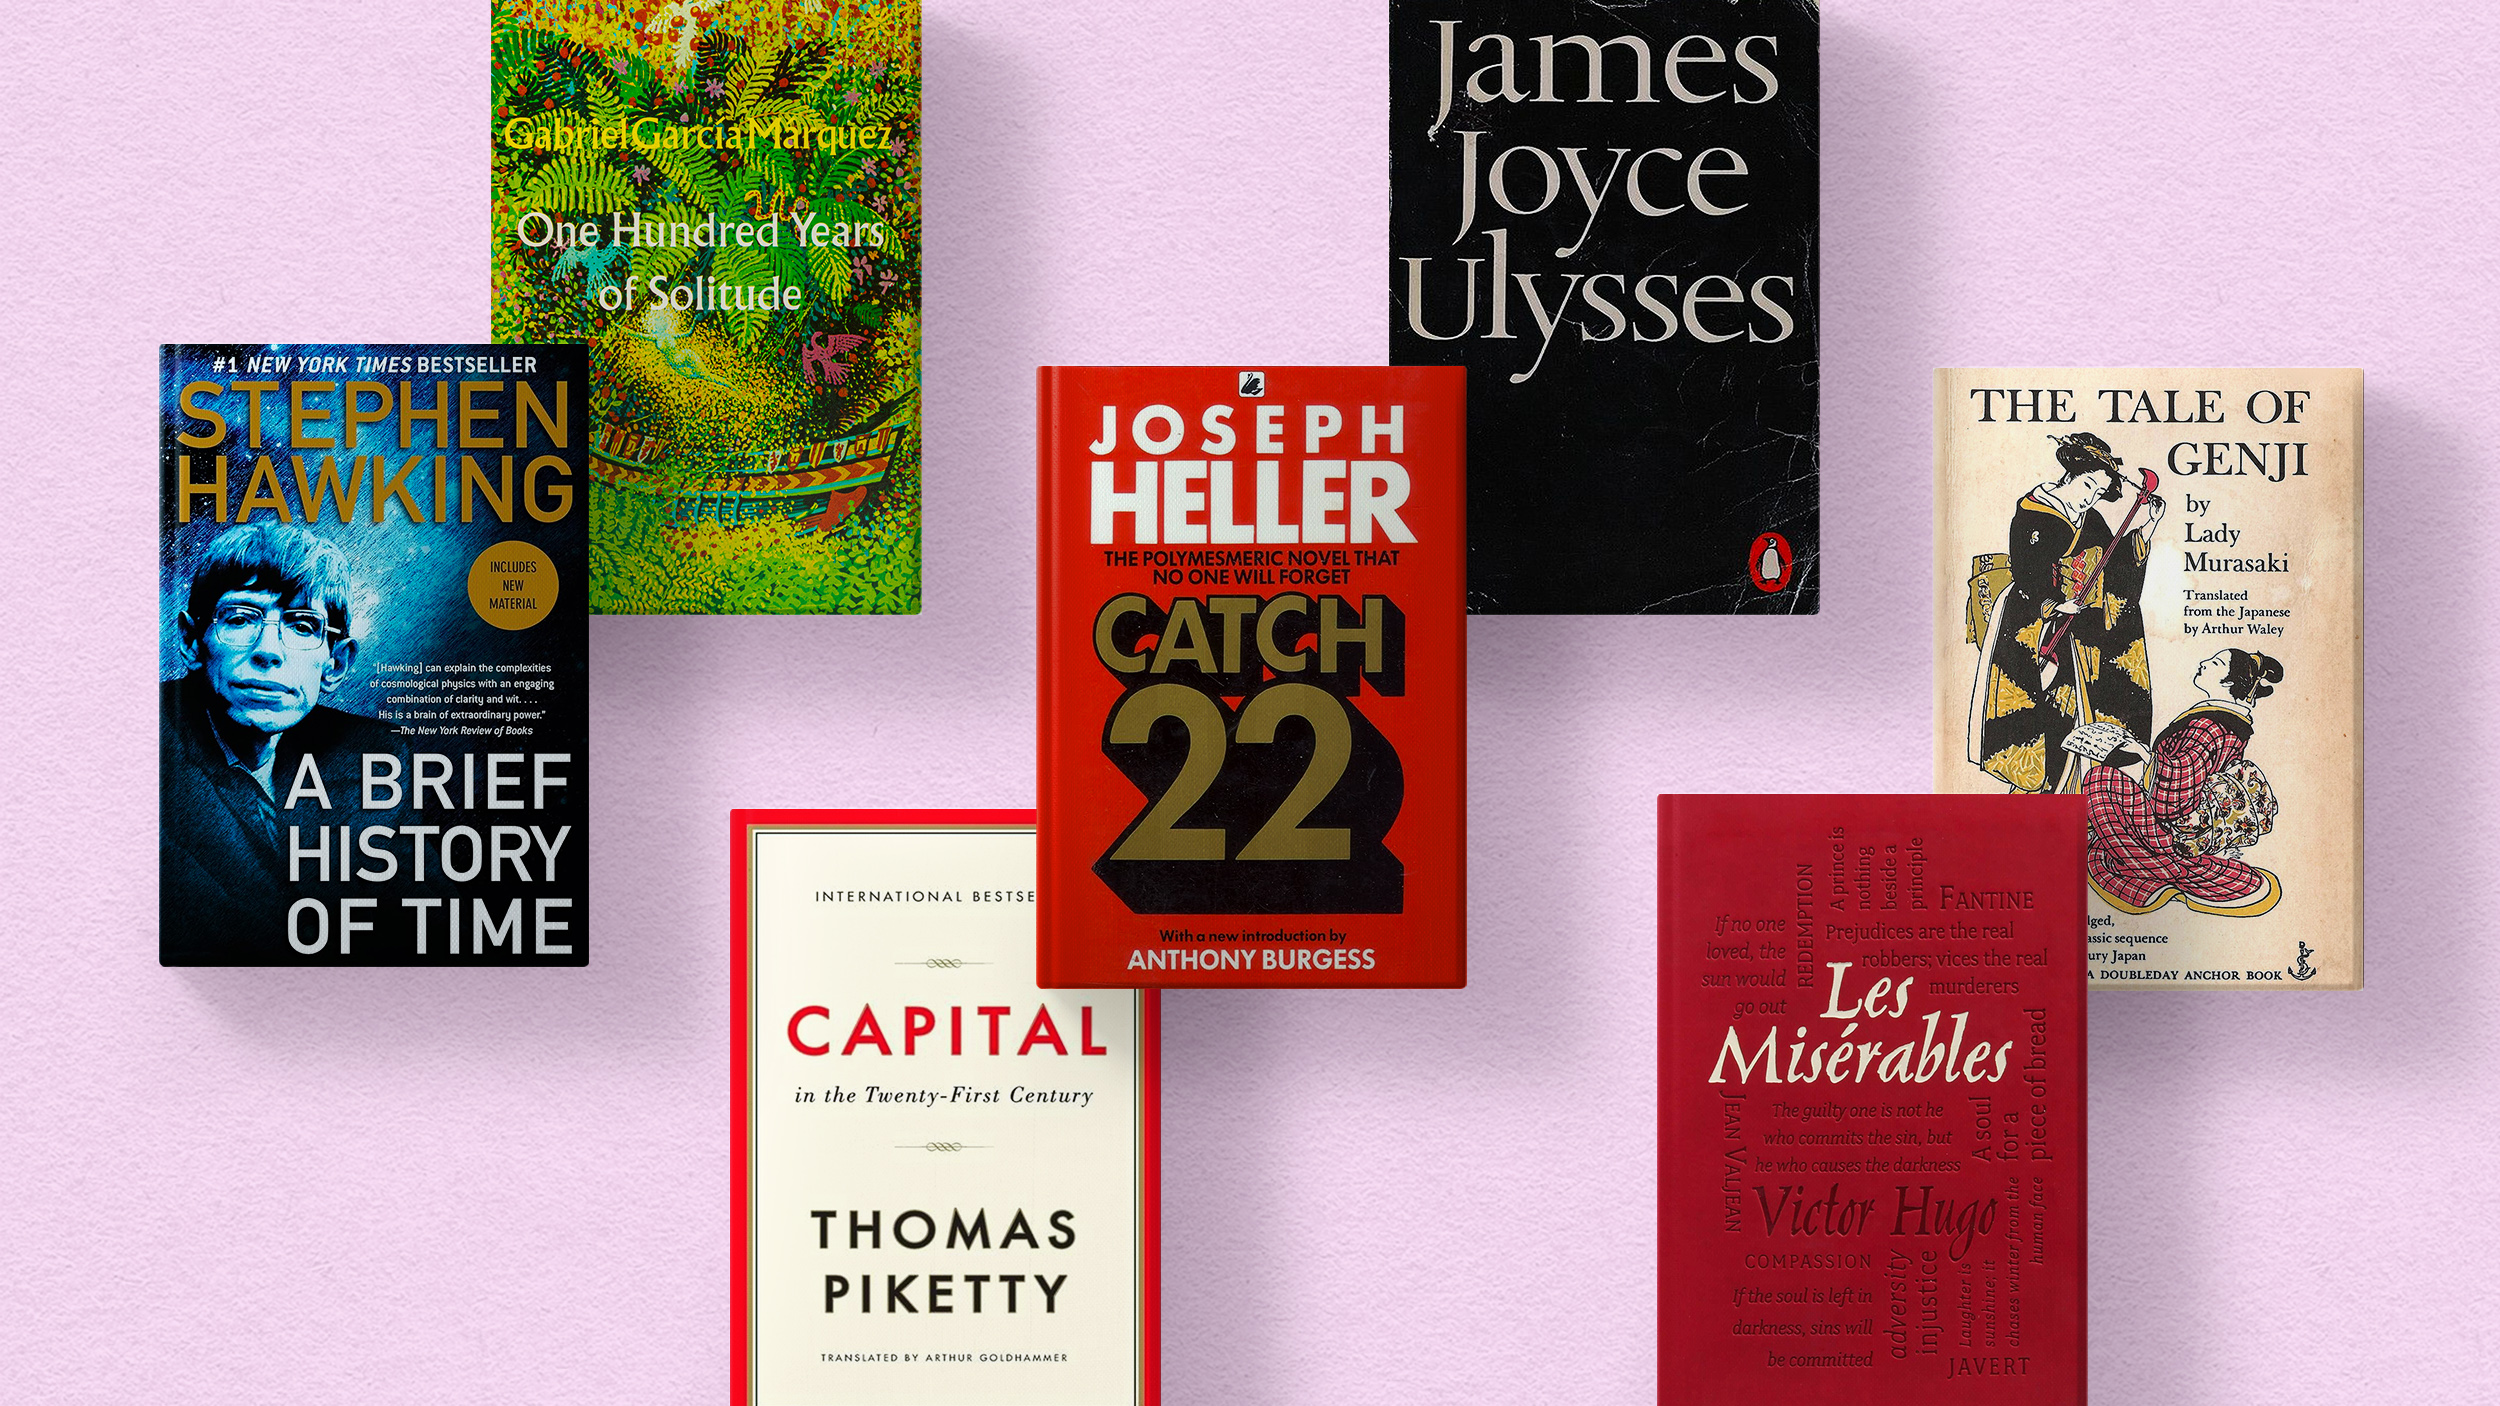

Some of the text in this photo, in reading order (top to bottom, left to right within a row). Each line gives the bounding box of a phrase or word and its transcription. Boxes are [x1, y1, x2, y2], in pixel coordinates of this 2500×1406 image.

[1429, 20, 1780, 141] James
[1452, 130, 1749, 258] Joyce
[517, 211, 884, 247] One Hundred Years
[599, 276, 801, 310] of Solitude
[1399, 228, 1794, 384] Ulysses
[213, 357, 537, 374] #1 NEW YORK TIMES BESTSELLER
[176, 381, 568, 448] STEPHEN
[1970, 389, 2311, 424] THE TALE OF
[1088, 404, 1404, 455] JOSEPH
[2167, 443, 2309, 482] GENJI
[179, 455, 573, 523] HAWKING
[1090, 460, 1419, 544] HELLER
[2186, 494, 2211, 516] by
[2184, 523, 2240, 545] Lady
[490, 560, 537, 574] INCLUDES
[1104, 550, 1400, 567] THE POLYMESMERIC NOVEL THAT
[2183, 553, 2289, 573] Murasaki
[503, 579, 524, 591] NEW
[1153, 569, 1350, 585] NO ONE WILL FORGET
[489, 597, 537, 610] MATERIAL
[2183, 590, 2248, 601] Translated
[2184, 606, 2291, 621] from the Japanese
[1095, 591, 1383, 674] CATCH
[2184, 623, 2284, 637] by Arthur Waley
[445, 664, 476, 674] explain
[479, 664, 493, 672] the
[496, 664, 551, 674] complexities
[370, 679, 379, 688] of
[381, 679, 438, 690] cosmological
[442, 679, 475, 690] physics
[478, 679, 497, 688] with
[514, 680, 554, 690] engaging
[387, 695, 441, 703] combination
[444, 695, 454, 703] of
[455, 695, 483, 706] clarity
[487, 695, 503, 703] and
[379, 710, 392, 719] His
[395, 710, 403, 719] is
[414, 710, 436, 719] brain
[440, 710, 449, 719] of
[451, 710, 511, 721] extraordinary
[418, 726, 437, 735] New
[440, 726, 458, 735] York
[461, 726, 491, 735] Review
[494, 726, 503, 737] of
[506, 726, 533, 735] Books
[284, 753, 571, 810] A BRIEF
[1109, 683, 1352, 860] 22
[289, 825, 572, 883] HISTORY
[1829, 826, 1848, 911] A prince is
[1854, 847, 1875, 910] nothing
[1880, 845, 1897, 910] beside a
[1907, 837, 1927, 911] principle
[816, 891, 1036, 903] INTERNATIONAL BESTSE
[288, 898, 573, 955] OF TIME
[1715, 915, 1786, 936] If no one
[1797, 864, 1813, 989] REDEMPTION
[1826, 922, 2014, 945] Prejudices are the real
[1159, 929, 1347, 945] With a new introduction by
[2115, 934, 2168, 947] sequence
[1127, 948, 1375, 970] ANTHONY BURGESS
[1706, 942, 1786, 962] loved, the
[1862, 948, 2048, 969] robbers; vices the real
[2111, 951, 2146, 964] Japan
[1702, 970, 1787, 988] sun would
[1929, 977, 2019, 995] murderers
[2101, 970, 2179, 980] DOUBLEDAY
[2184, 970, 2240, 980] ANCHOR
[2246, 970, 2283, 980] BOOK
[1820, 961, 1914, 1019] Les
[1733, 1000, 1787, 1020] go out
[787, 1003, 1107, 1056] CAPITAL
[1708, 1010, 2013, 1085] Misérables
[795, 1086, 1093, 1107] in the Twenty-First Century
[1772, 1102, 1944, 1122] The guilty one is not he
[811, 1208, 1076, 1251] THOMAS
[1751, 1183, 1998, 1262] Victor Hugo
[1745, 1254, 1872, 1269] COMPASSION
[825, 1274, 1068, 1313] PIKETTY
[1883, 1248, 1913, 1360] adversity
[1915, 1249, 1943, 1355] injustice
[821, 1354, 1068, 1362] TRANSLATED BY ARTHUR GOLDHAMMER
[1947, 1357, 2031, 1380] JAVERT
